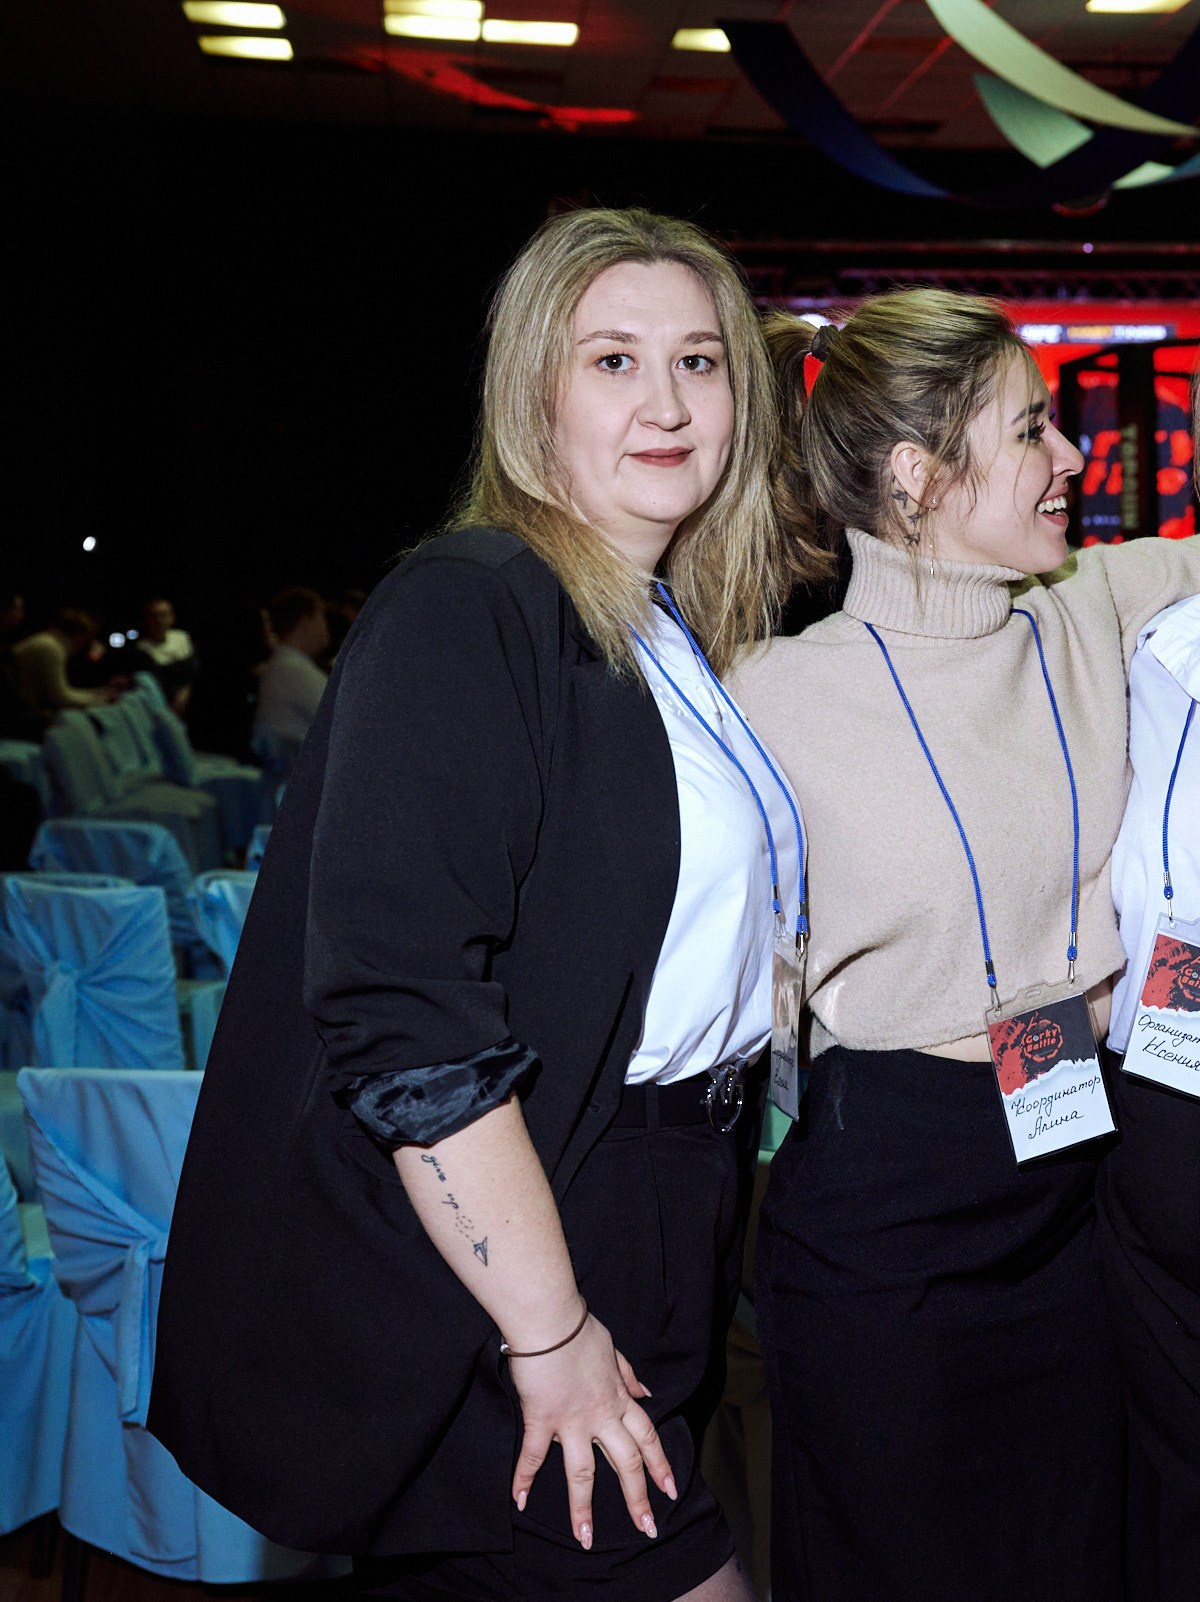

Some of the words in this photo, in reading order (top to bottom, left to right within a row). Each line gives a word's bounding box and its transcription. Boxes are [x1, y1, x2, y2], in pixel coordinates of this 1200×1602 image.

[1025, 1028, 1058, 1044] Gorky
[1142, 1036, 1200, 1071] Ксения
[1010, 1075, 1101, 1117] Координатор
[421, 1153, 447, 1182] give
[442, 1193, 459, 1210] up
